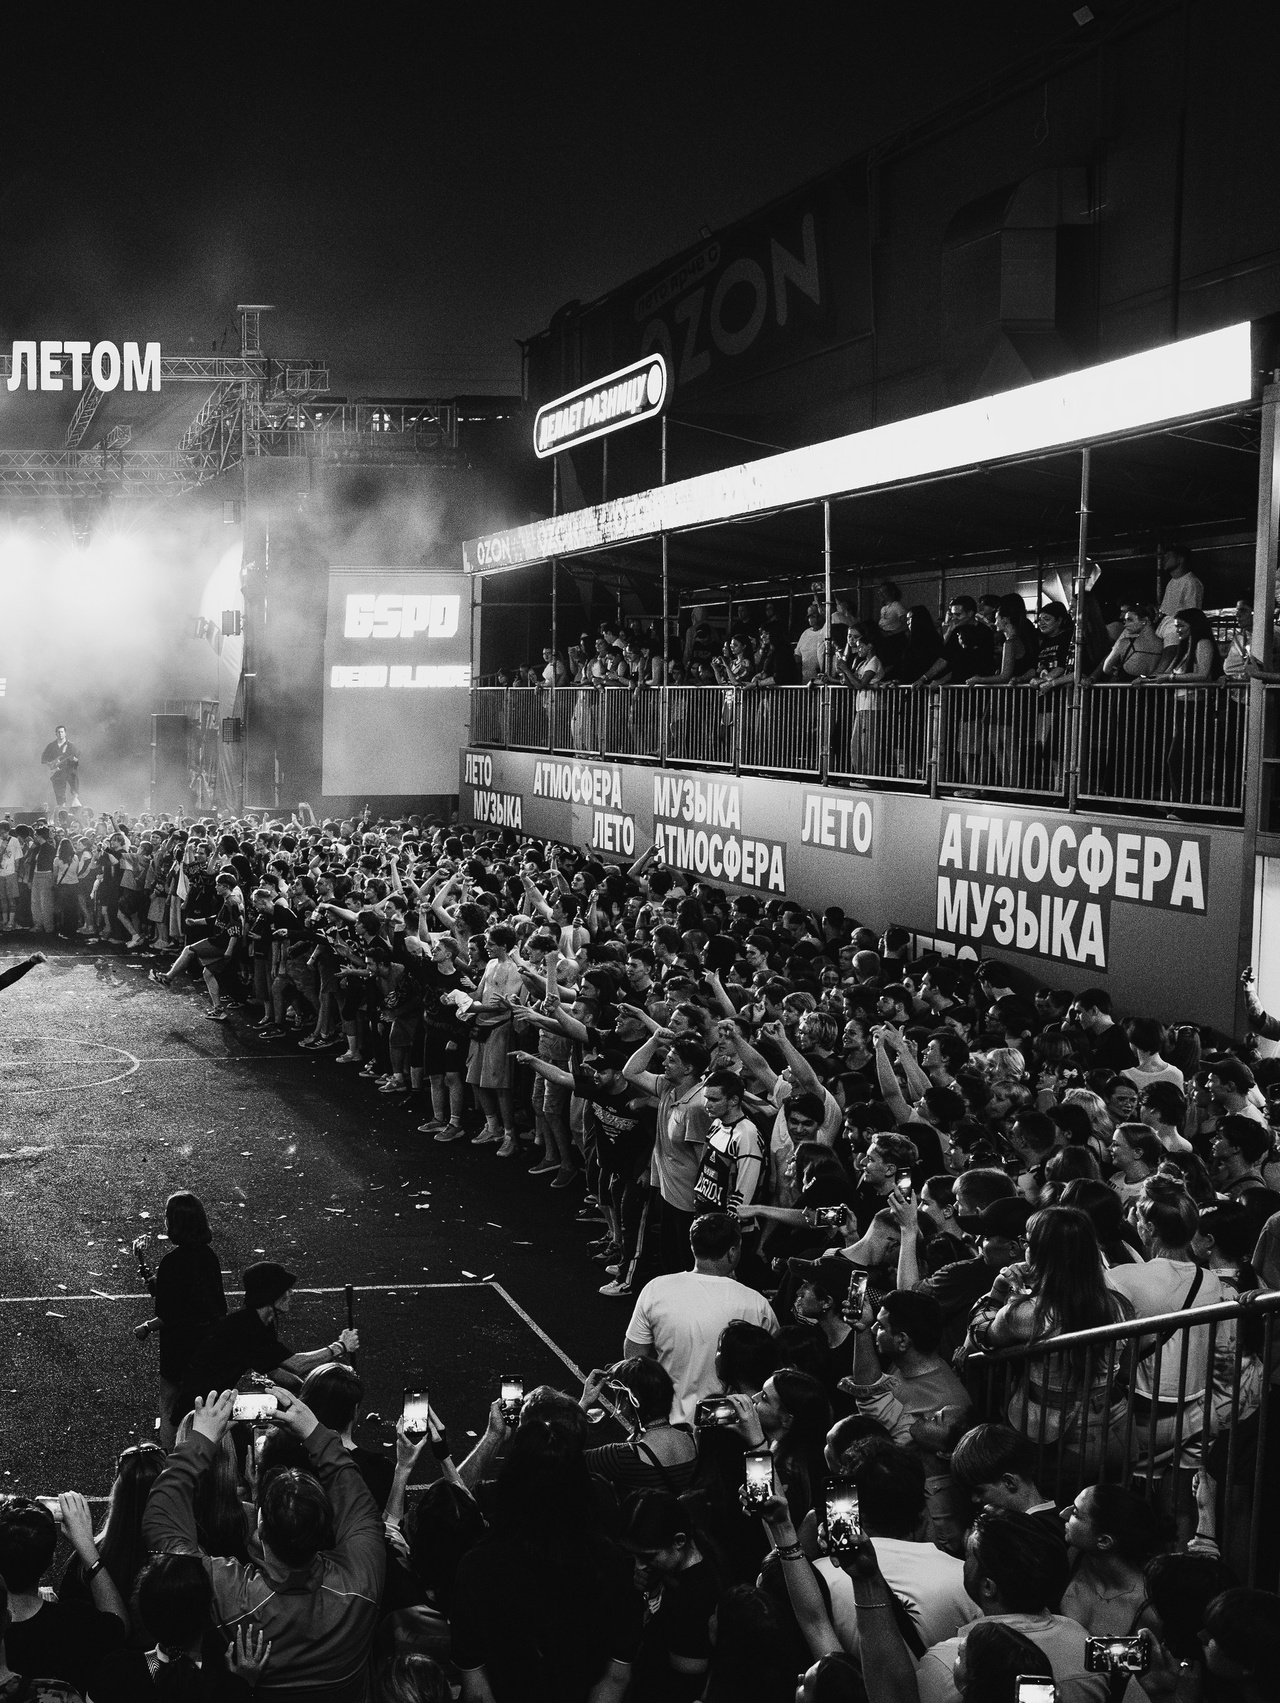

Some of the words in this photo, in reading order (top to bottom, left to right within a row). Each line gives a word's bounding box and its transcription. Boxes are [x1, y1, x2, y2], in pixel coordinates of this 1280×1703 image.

[7, 340, 161, 392] ЛЕТОМ
[539, 401, 584, 451] ДЕЛАЕТ
[583, 373, 648, 428] РАЗНИЦУ
[476, 534, 511, 565] OZON
[344, 594, 461, 638] GSPD
[330, 665, 388, 688] DEAD
[389, 665, 471, 688] BLONDE
[464, 753, 493, 787] ЛЕТО
[533, 761, 622, 809] АТМОСФЕРА
[473, 790, 522, 830] МУЗЫКА
[653, 775, 741, 831] МУЗЫКА
[802, 794, 872, 853] ЛЕТО
[592, 811, 635, 856] ЛЕТО
[653, 822, 785, 893] АТМОСФЕРА
[938, 812, 1205, 910] АТМОСФЕРА
[936, 875, 1106, 968] МУЗЫКА
